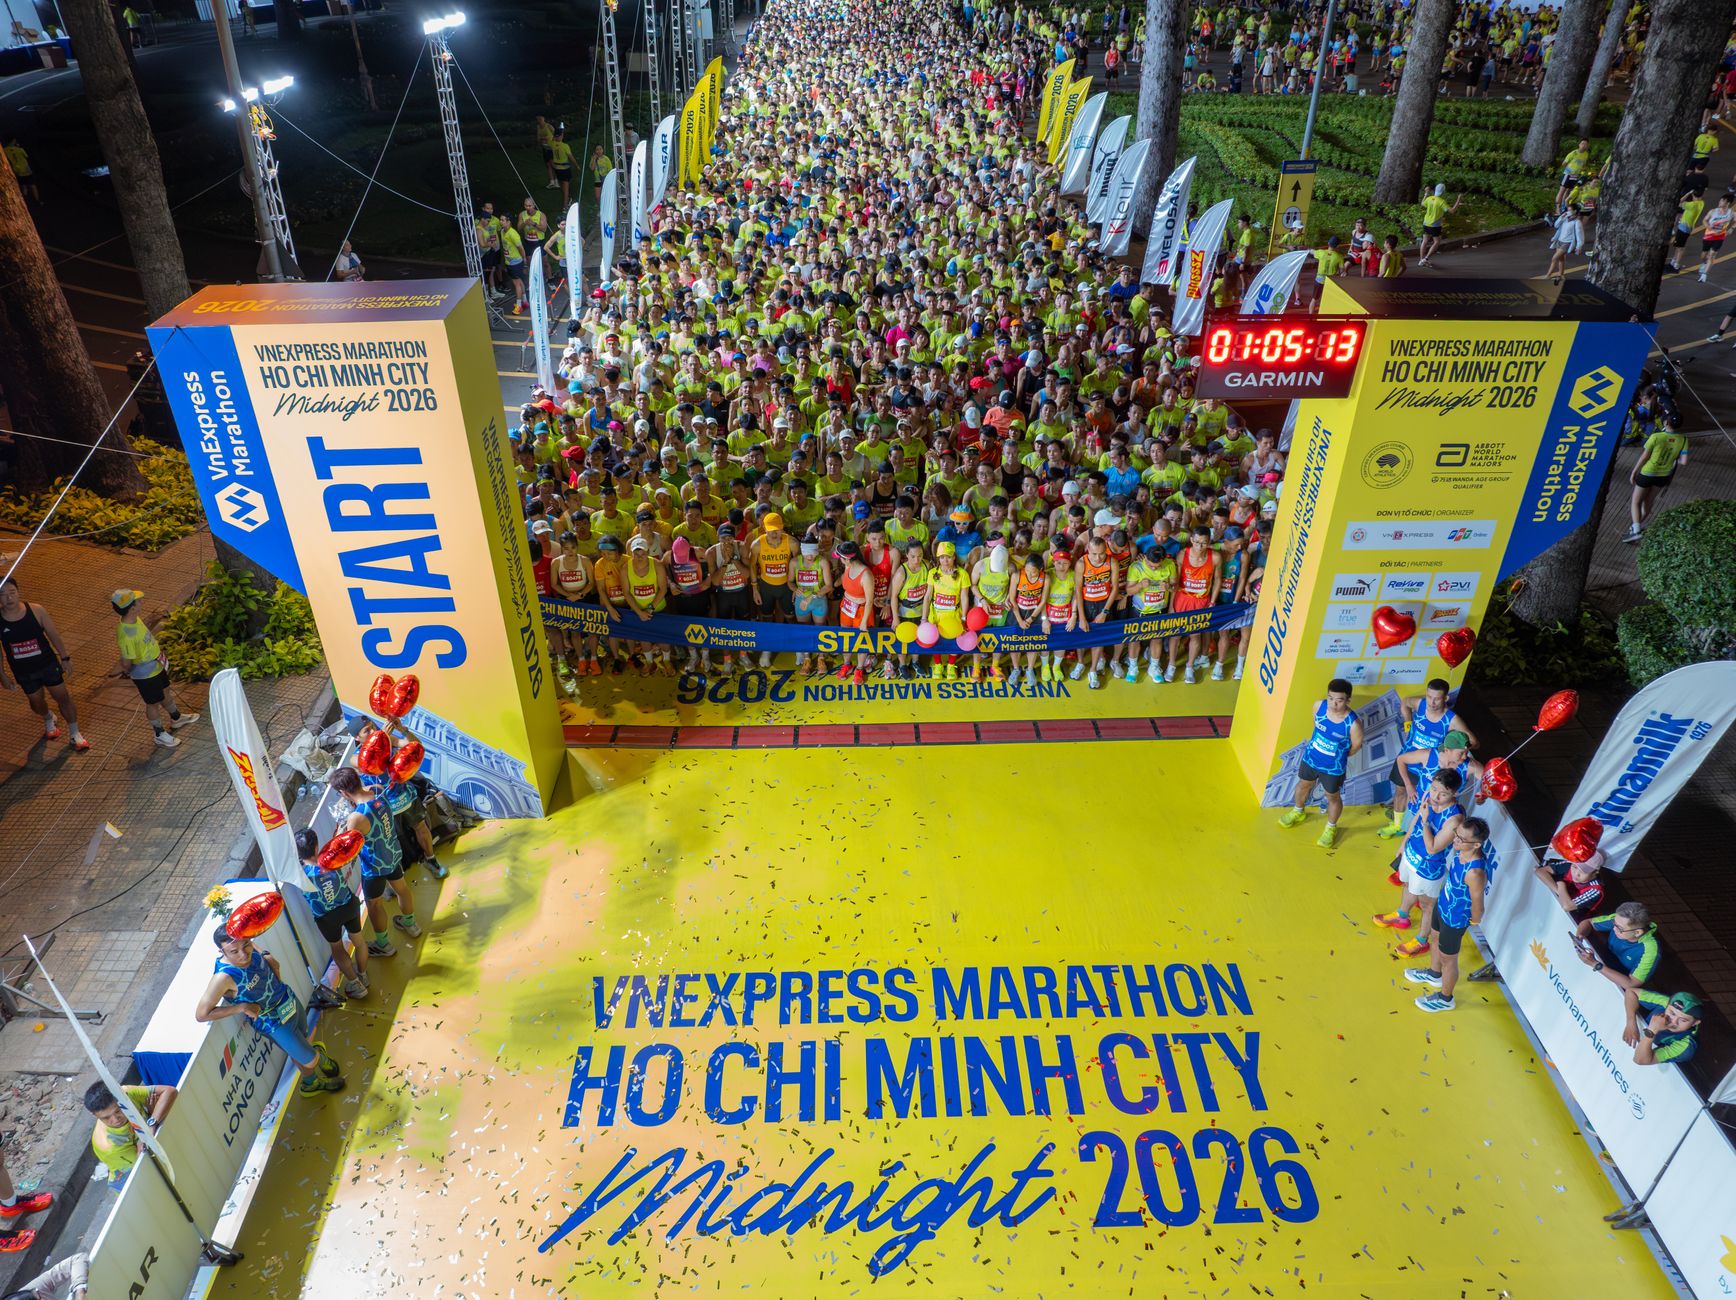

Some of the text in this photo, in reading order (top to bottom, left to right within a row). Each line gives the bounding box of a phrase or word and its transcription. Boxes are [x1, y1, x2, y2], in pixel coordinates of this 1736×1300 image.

[1052, 74, 1064, 96] 2026
[1065, 93, 1079, 116] 2026
[686, 110, 694, 135] 2026
[193, 300, 271, 314] 2026
[270, 302, 355, 312] MARATHON
[356, 299, 441, 310] VNEXPRESS
[254, 340, 427, 362] VNEXPRESS MARATHON
[1209, 329, 1358, 362] 01:05:13
[1390, 339, 1553, 357] VNEXPRESS MARATHON
[260, 362, 429, 388] HO CHI MINH CITY
[1224, 371, 1324, 388] GARMIN
[1381, 361, 1547, 383] HO CHI MINH CITY
[273, 388, 438, 421] Midnight 2026
[1375, 386, 1538, 417] Midnight 2026
[183, 371, 229, 481] VnExpress
[215, 370, 254, 477] Marathon
[1310, 416, 1322, 438] HO
[485, 451, 496, 477] CHI
[1304, 438, 1316, 468] CHI
[1532, 424, 1580, 523] Marathon
[1556, 419, 1608, 522] VnExpress
[1297, 466, 1311, 505] MINH
[488, 416, 530, 611] VNEXPRESS MARATHON
[1286, 427, 1333, 619] VNEXPRESS MARATHON
[1291, 501, 1304, 529] CITY
[306, 436, 468, 670] START
[1335, 586, 1366, 596] PUMA
[1450, 581, 1472, 589] PVI
[539, 601, 609, 624] CHI MINH CITY
[540, 615, 581, 632] idnight
[1124, 621, 1143, 634] HO
[1143, 619, 1159, 632] CHI
[1160, 616, 1188, 630] MINH
[708, 626, 756, 639] VnExpress
[709, 636, 756, 648] Marathon
[1000, 633, 1048, 643] VnExpress
[520, 610, 543, 700] 2026
[1001, 642, 1048, 651] Marathon
[1259, 606, 1288, 695] 2026
[677, 670, 796, 704] 2026
[804, 682, 932, 701] MARATHON
[937, 680, 1071, 699] VNEXPRESS
[1689, 720, 1713, 741] 1976
[1586, 712, 1695, 828] Vinamilk
[592, 963, 1254, 1030] VNEXPRESS MARATHON
[559, 1030, 1268, 1128] HO CHI MINH CITY
[222, 1073, 242, 1113] NHÀ
[224, 1039, 274, 1147] LONG CH
[538, 1127, 1321, 1277] Midnight 2026
